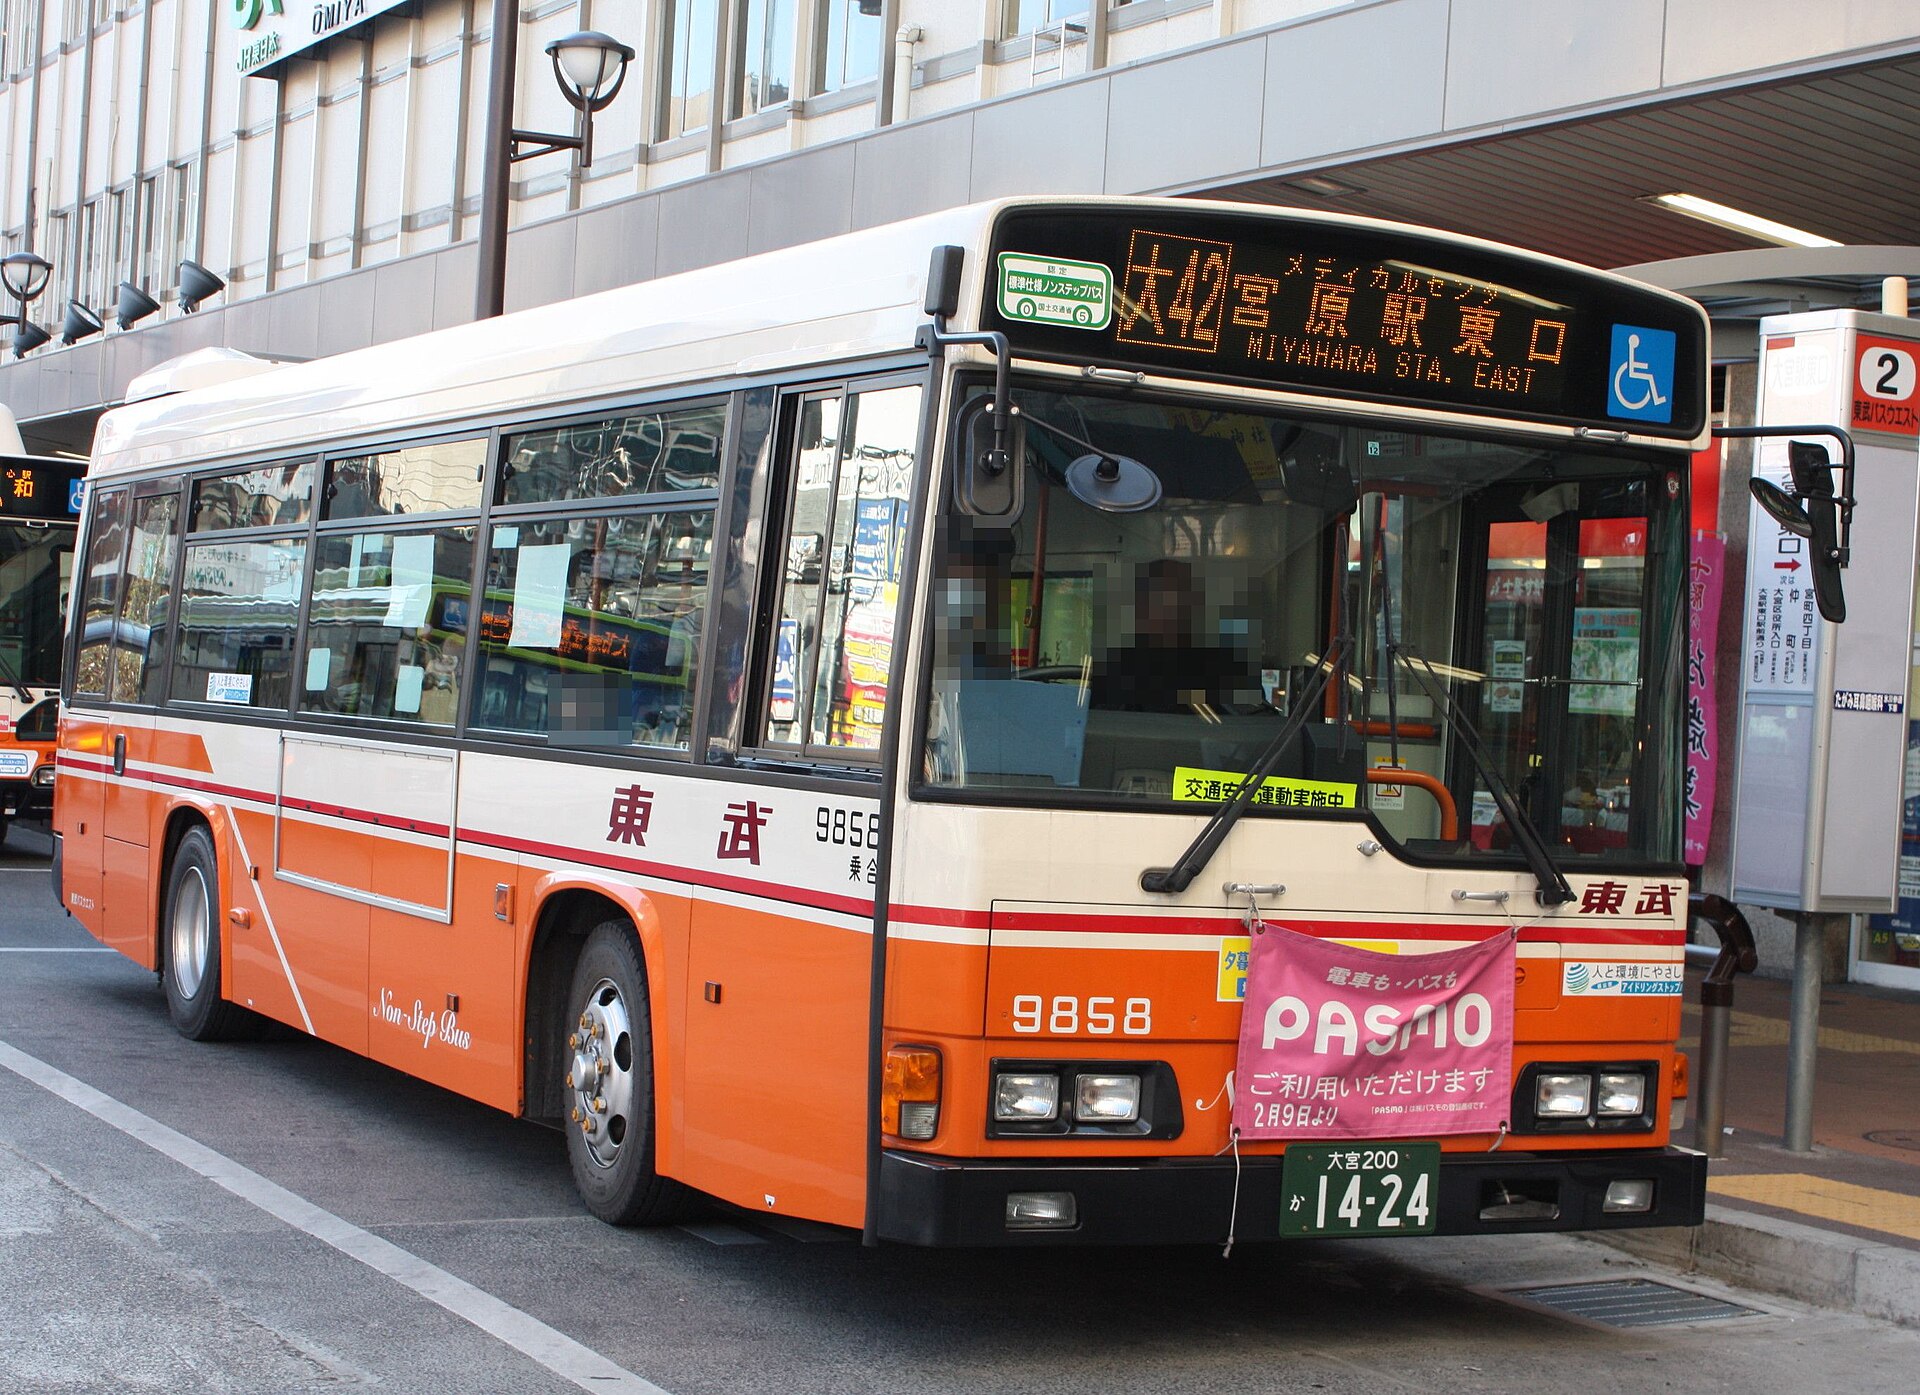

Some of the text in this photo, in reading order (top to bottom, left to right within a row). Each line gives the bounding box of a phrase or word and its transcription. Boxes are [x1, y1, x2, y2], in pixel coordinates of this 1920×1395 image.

[1008, 275, 1102, 299] 標準仕様ノンステップバス
[1284, 253, 1526, 304] メディカルセンター
[1038, 302, 1072, 314] 国土交通省
[1079, 311, 1087, 321] 5
[1233, 273, 1566, 364] 宮原駅東口
[1247, 331, 1536, 394] MIYAHARA STA. EAST
[1875, 353, 1900, 396] 2
[1853, 400, 1920, 429] 東武バスウエスト
[1185, 777, 1344, 808] 交通安運動実施中
[606, 784, 774, 866] 東武
[816, 806, 880, 849] 9858
[1578, 881, 1682, 915] 東武
[1592, 965, 1682, 979] 人と環境にやさし
[1622, 982, 1683, 993] アイドリングストップ
[373, 987, 471, 1050] Non-Step Bus
[1013, 995, 1151, 1034] 9858
[1261, 993, 1492, 1056] PASMO
[1250, 1067, 1494, 1101] ご利用いただけます
[1253, 1102, 1338, 1128] 2月9日より
[1327, 1150, 1399, 1171] 大宮200
[1289, 1194, 1306, 1212] か
[1316, 1173, 1429, 1229] 14-24
